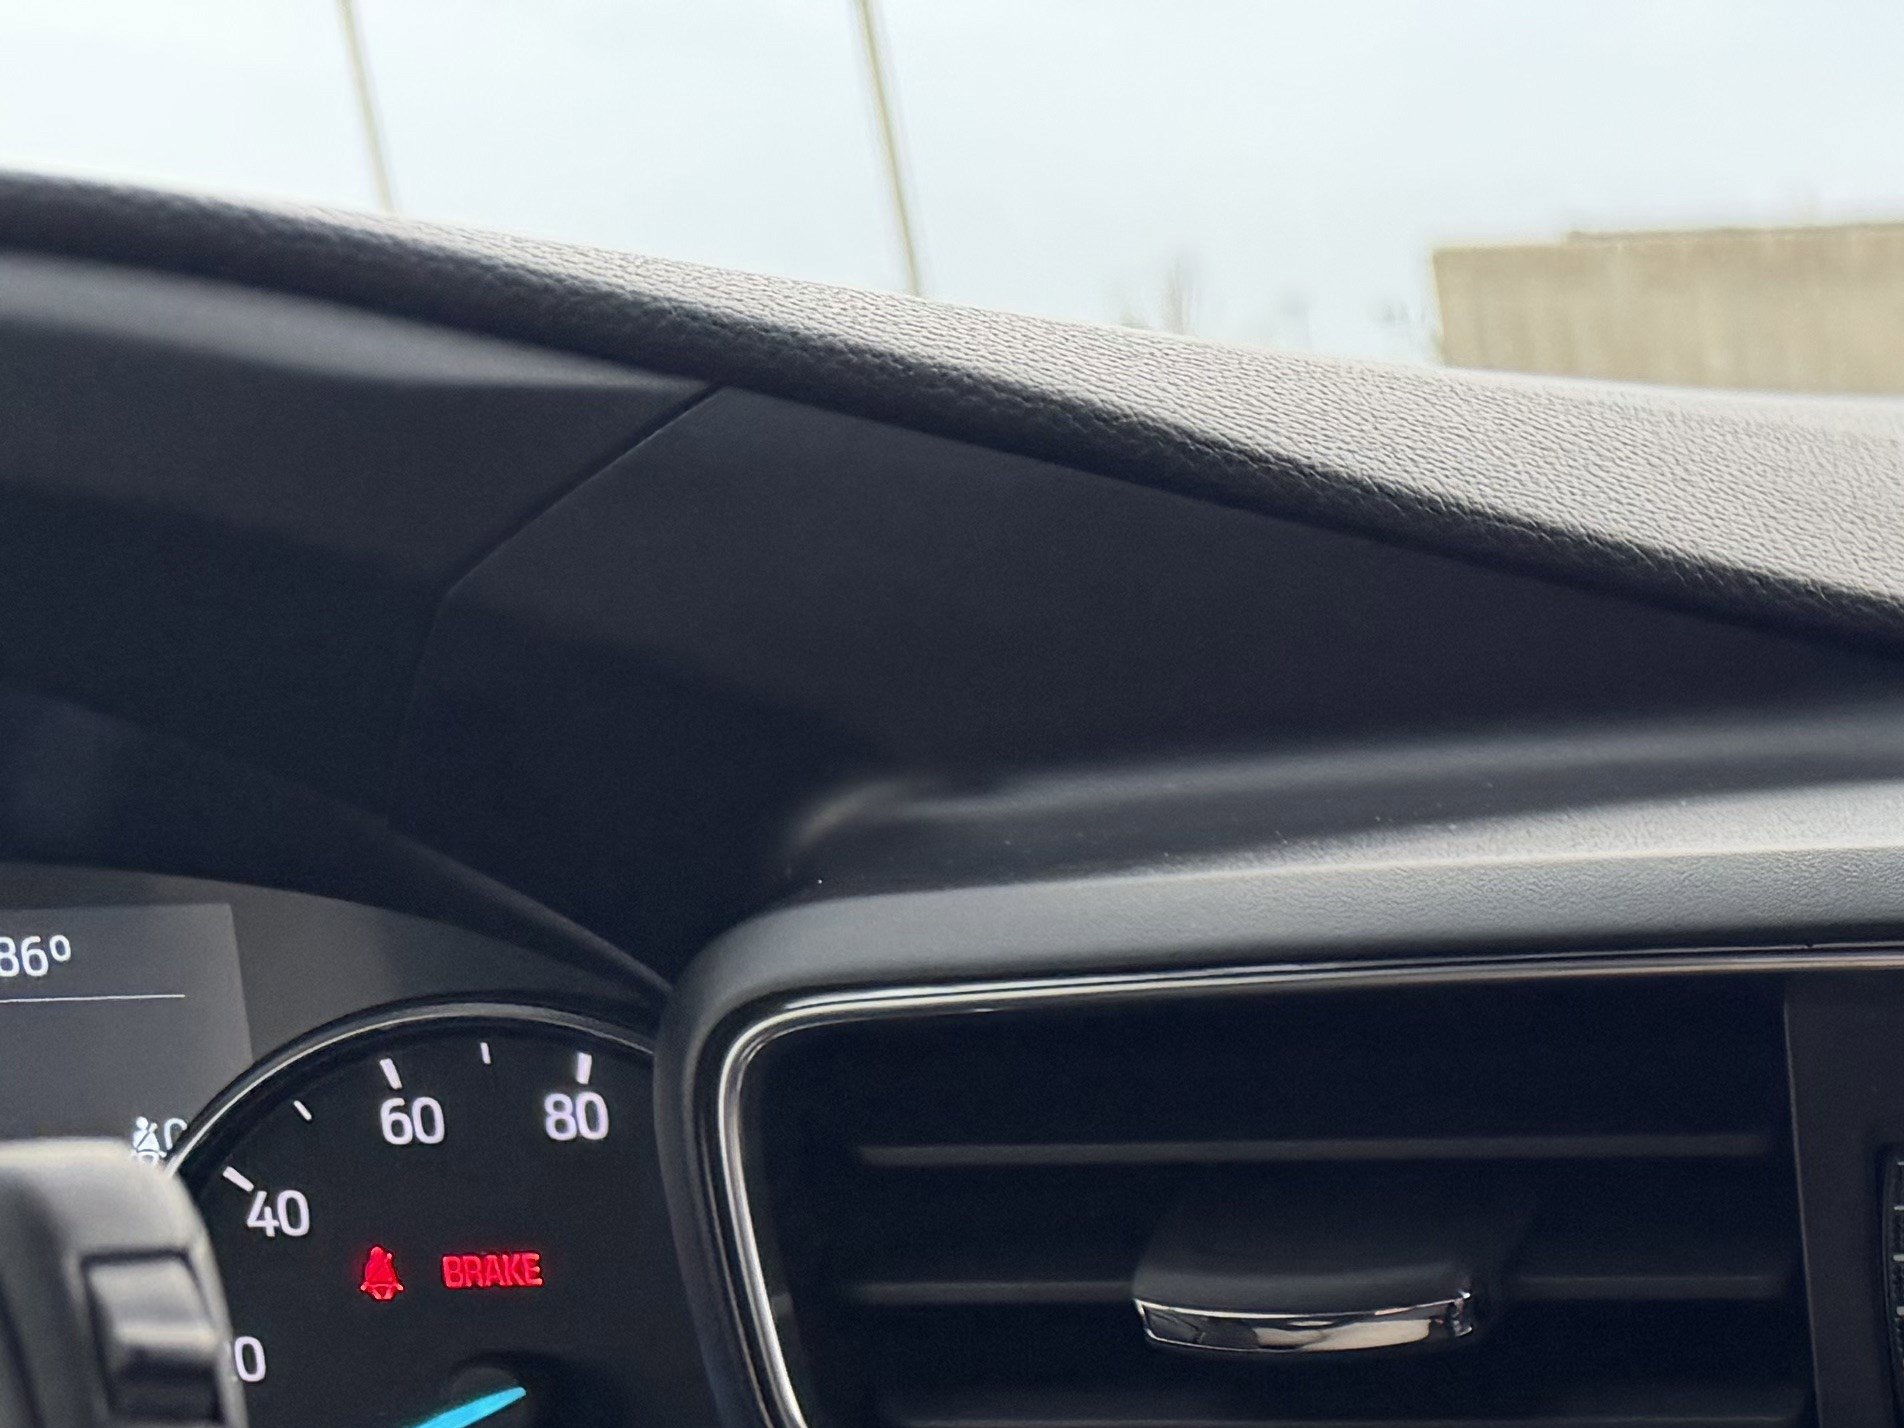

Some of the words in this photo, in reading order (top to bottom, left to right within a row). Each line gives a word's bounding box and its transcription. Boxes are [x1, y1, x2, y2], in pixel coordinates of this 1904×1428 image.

[380, 1096, 445, 1145] 60
[544, 1091, 609, 1141] 80
[243, 1187, 311, 1238] 40
[442, 1252, 541, 1289] BRAKE
